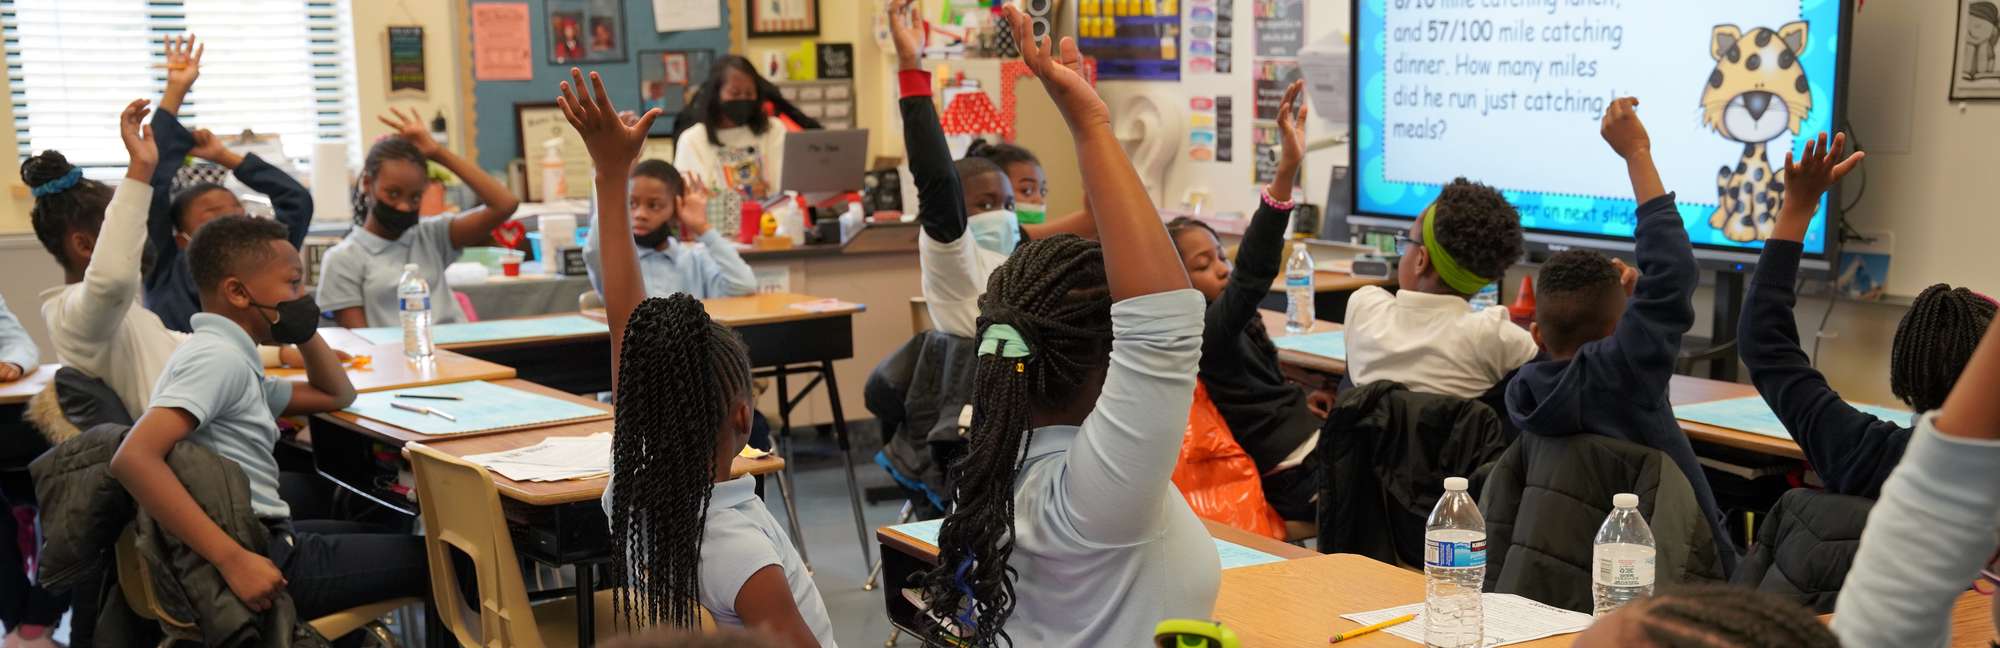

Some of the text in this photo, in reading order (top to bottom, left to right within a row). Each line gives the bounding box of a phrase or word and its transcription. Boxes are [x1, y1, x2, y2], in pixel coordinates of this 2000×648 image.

[1393, 17, 1623, 49] and 57/100 mile catching
[1393, 53, 1597, 82] dinner. How many miles
[1393, 85, 1418, 106] did
[1424, 86, 1443, 107] he
[1449, 91, 1477, 109] run
[1481, 87, 1518, 116] just
[1524, 88, 1604, 120] catching
[1393, 118, 1447, 140] meals?
[1543, 206, 1560, 219] on
[1564, 205, 1597, 222] next
